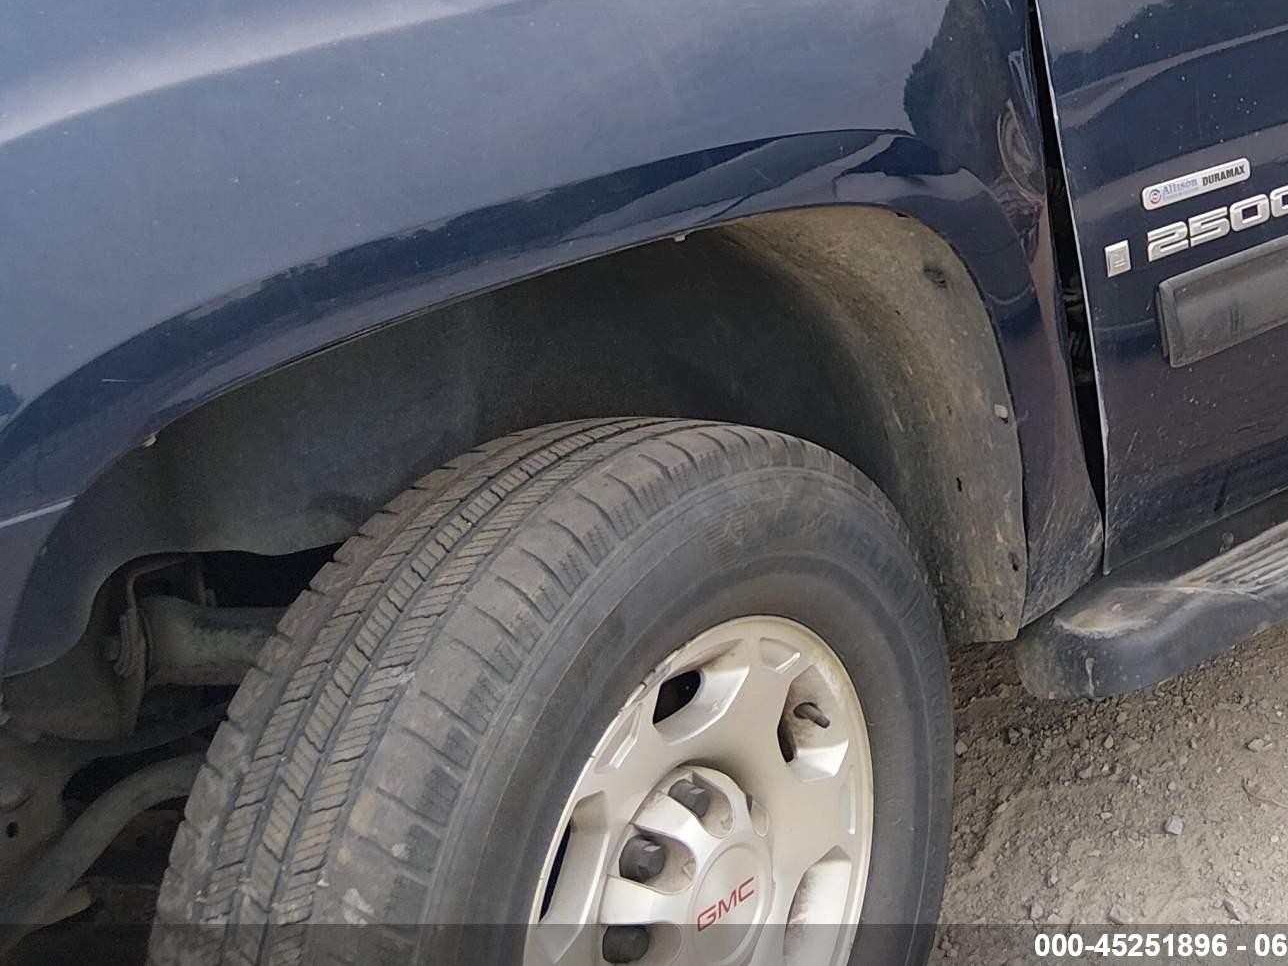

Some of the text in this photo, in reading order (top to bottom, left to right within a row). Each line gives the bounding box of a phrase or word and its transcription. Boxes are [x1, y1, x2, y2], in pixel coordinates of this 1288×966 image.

[1162, 177, 1198, 197] Allison
[1202, 164, 1245, 186] DURAMAX
[697, 876, 755, 932] GMC
